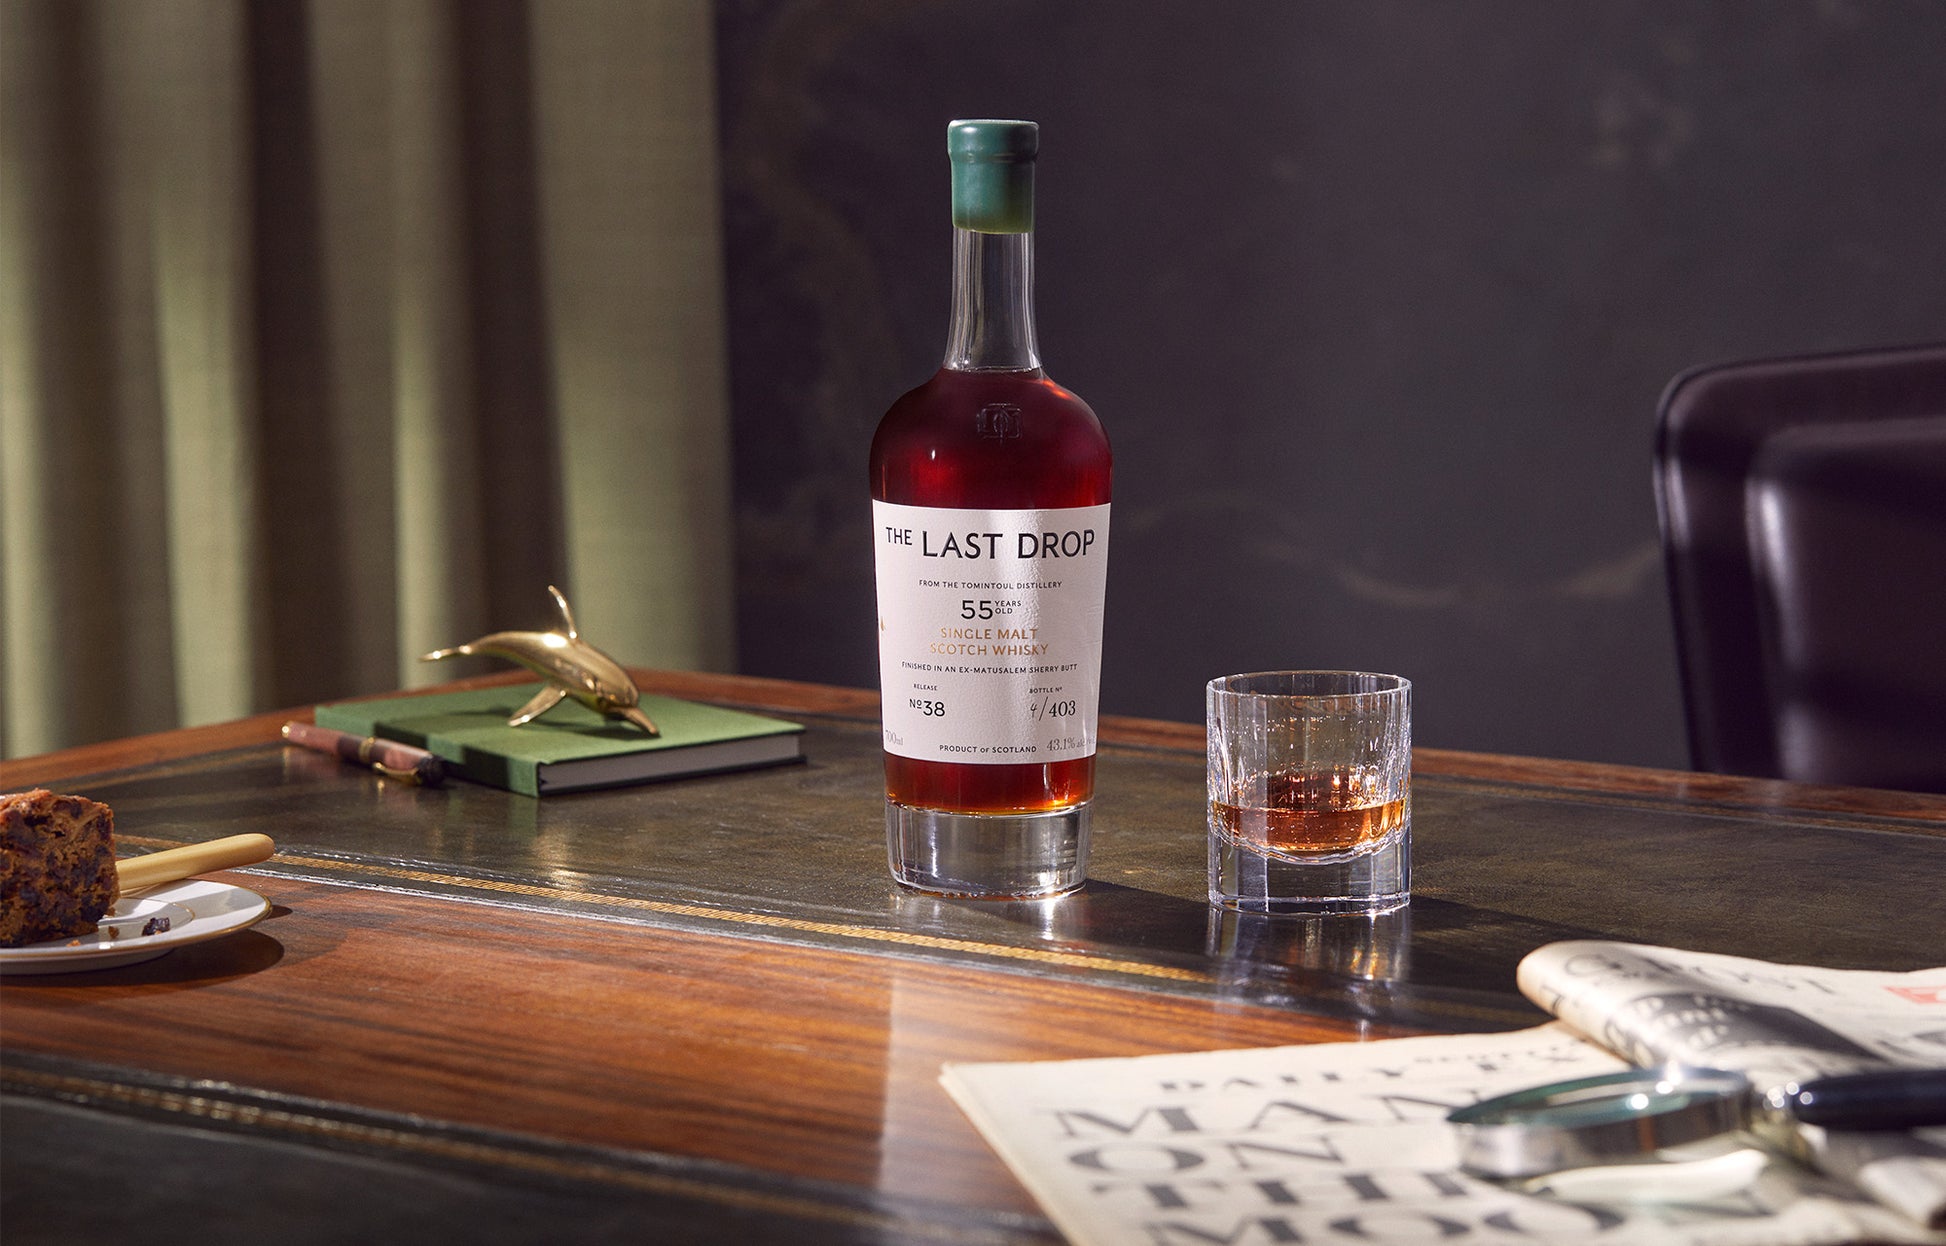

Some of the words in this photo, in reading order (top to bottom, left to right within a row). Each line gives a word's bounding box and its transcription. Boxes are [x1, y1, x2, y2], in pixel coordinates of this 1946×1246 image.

[885, 526, 913, 546] THE
[922, 530, 1003, 560] LAST
[1017, 528, 1095, 559] DROP
[918, 579, 940, 588] FROM
[942, 580, 959, 589] THE
[961, 581, 1014, 590] TOMINTOUL
[1016, 580, 1062, 590] DISTILLERY
[960, 599, 994, 621] 55
[994, 600, 1022, 608] YEARS
[994, 607, 1013, 615] OLD
[940, 627, 992, 640] SINGLE
[997, 628, 1039, 640] MALT
[930, 642, 988, 656] SCOTCH
[991, 643, 1049, 656] WHISKY
[901, 661, 932, 672] FINISHED
[933, 664, 943, 673] IN
[944, 665, 957, 674] AN
[958, 666, 1027, 675] EX-MATUSALEM
[1028, 665, 1059, 674] SHERRY
[1060, 663, 1078, 673] BUTT
[913, 683, 938, 692] RELEASE
[1028, 687, 1054, 695] BOTTLE
[939, 744, 978, 753] PRODUCT
[991, 745, 1037, 754] SCOTLAND
[1046, 737, 1076, 751] 43.1%
[1050, 1090, 1482, 1138] MAN
[1067, 1134, 1347, 1174] ON
